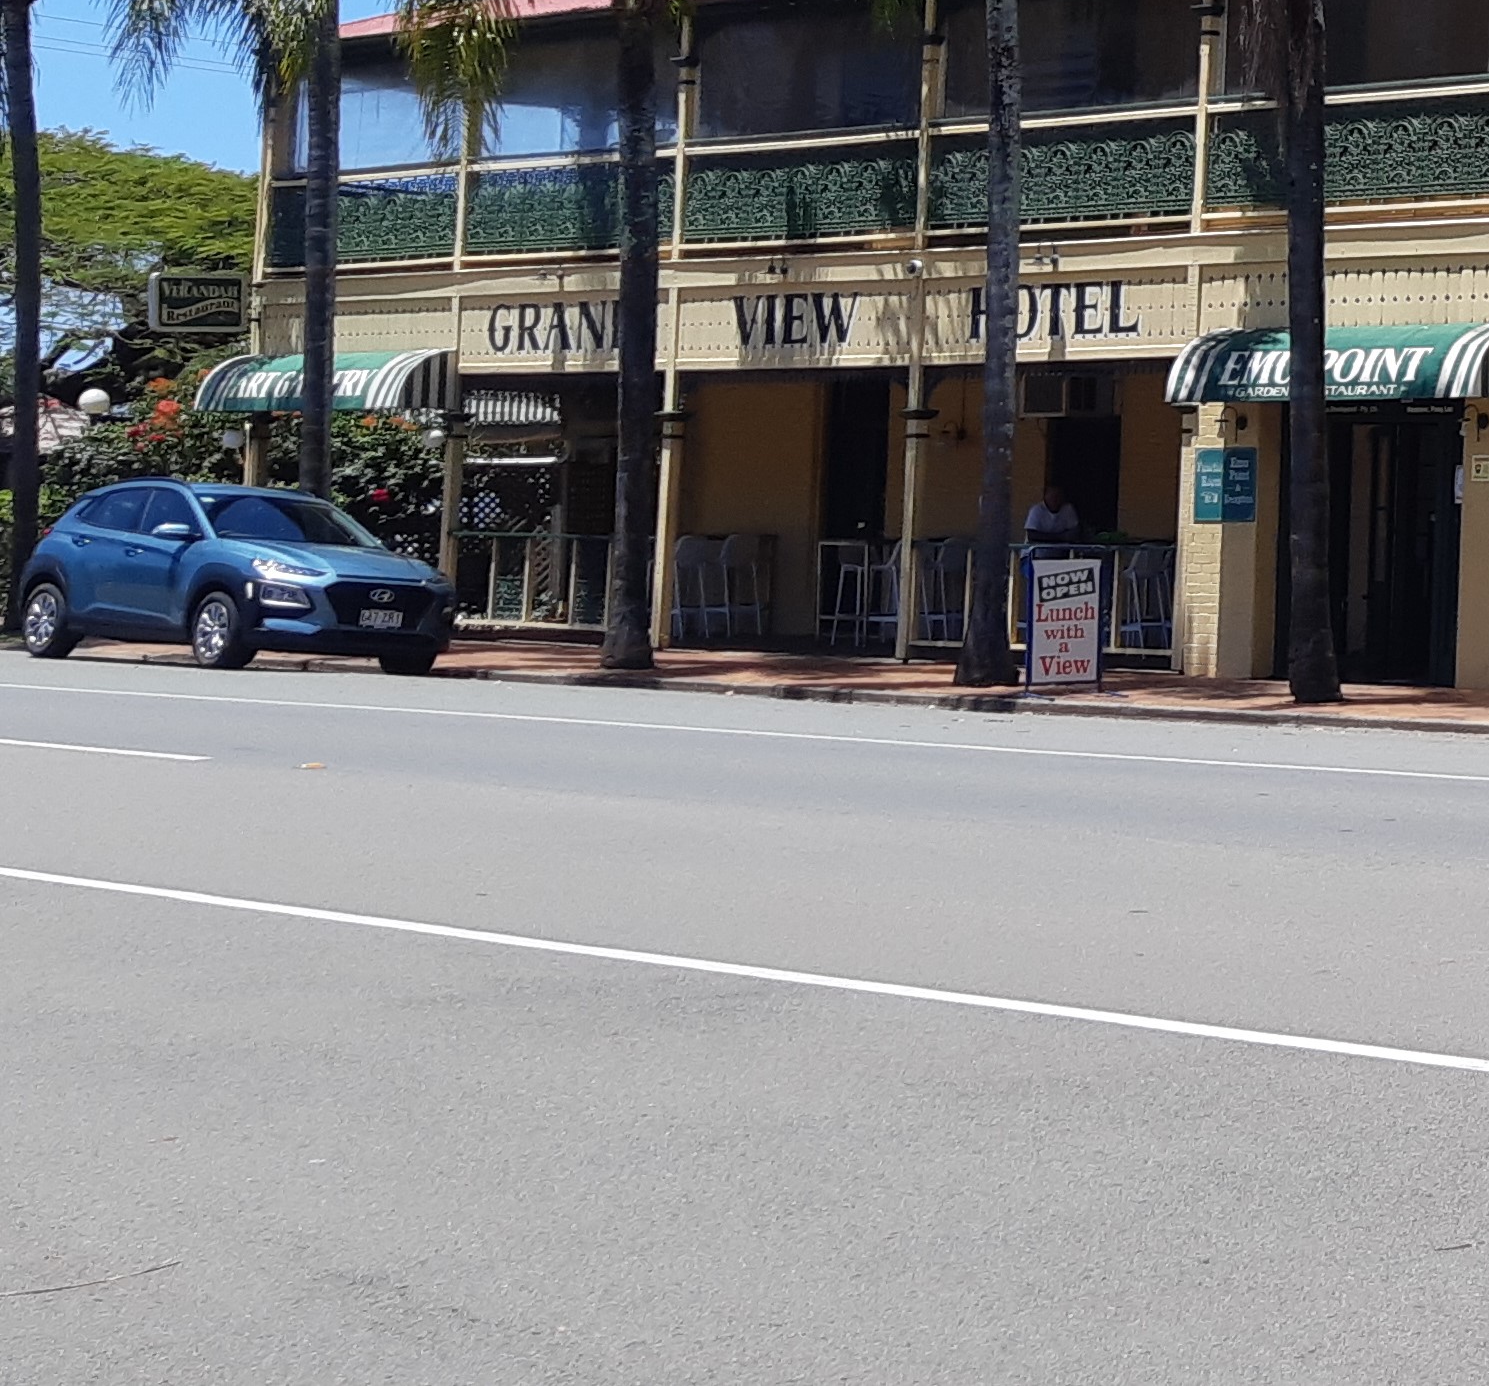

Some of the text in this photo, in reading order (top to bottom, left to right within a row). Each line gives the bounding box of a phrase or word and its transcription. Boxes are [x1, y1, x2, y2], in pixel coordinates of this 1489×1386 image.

[733, 292, 859, 346] VIEW
[228, 369, 380, 399] ART GAERY
[1235, 386, 1290, 398] GARDEN
[1042, 569, 1089, 588] NOW
[1041, 581, 1094, 600] OPEN
[1035, 601, 1096, 623] Lunch
[1044, 624, 1085, 640] with
[1059, 641, 1070, 653] a
[1039, 655, 1091, 676] View
